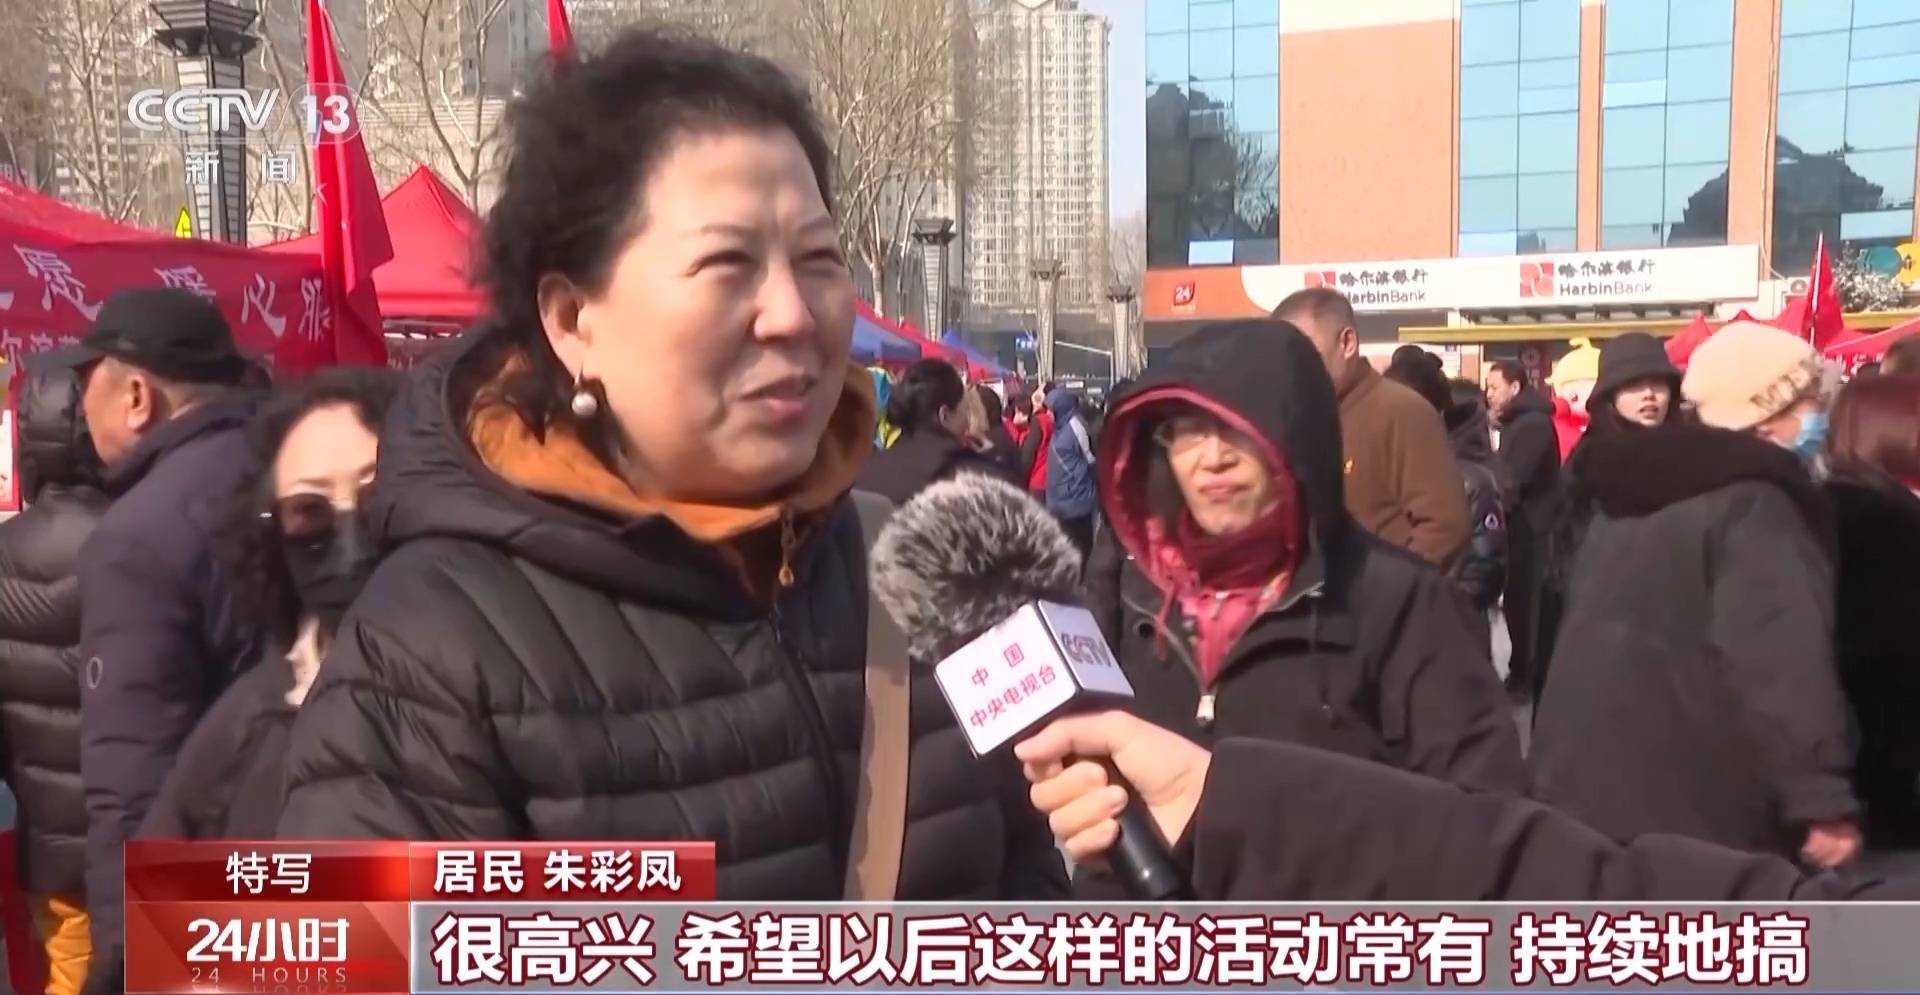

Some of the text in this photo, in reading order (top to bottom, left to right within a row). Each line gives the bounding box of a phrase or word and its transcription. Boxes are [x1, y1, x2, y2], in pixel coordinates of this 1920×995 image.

[1557, 258, 1656, 280] 哈尔滨银行
[1174, 285, 1191, 301] 24
[1559, 280, 1652, 297] HarbinBank
[970, 642, 1025, 688] 中国
[969, 664, 1057, 729] 中央电视台
